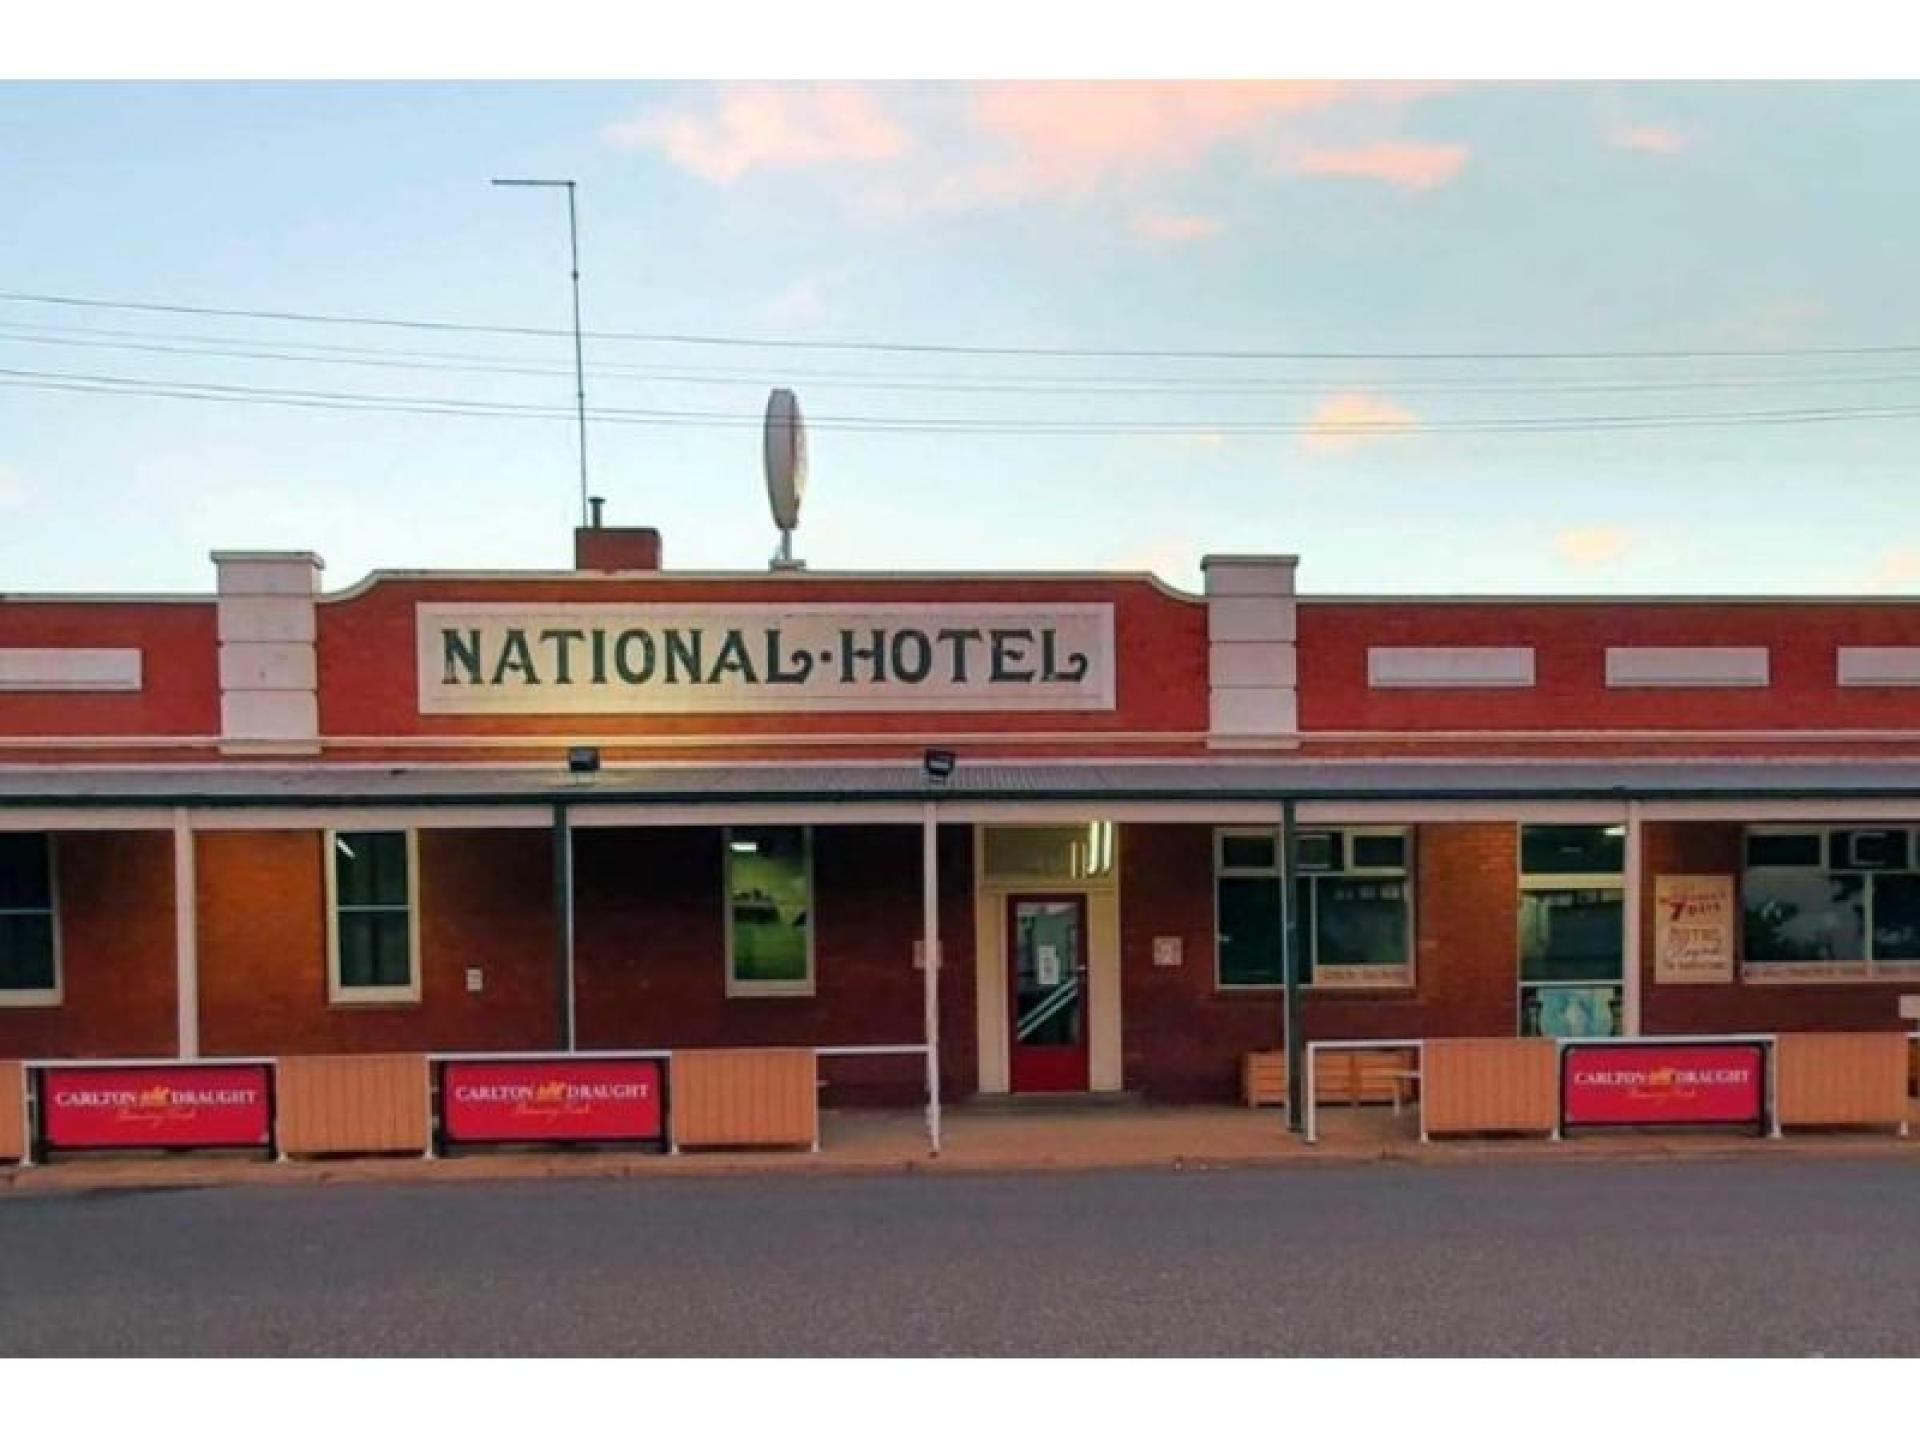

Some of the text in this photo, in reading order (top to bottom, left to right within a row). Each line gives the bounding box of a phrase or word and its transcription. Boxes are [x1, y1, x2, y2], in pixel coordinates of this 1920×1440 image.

[441, 628, 1089, 685] NATIONAL HOTEL
[1669, 901, 1685, 921] 7
[1573, 1069, 1749, 1085] CARLTON DRAUGHT
[56, 1091, 257, 1106] CARLTON DRAUGHT
[455, 1083, 649, 1101] CARLTON DRAUGHT
